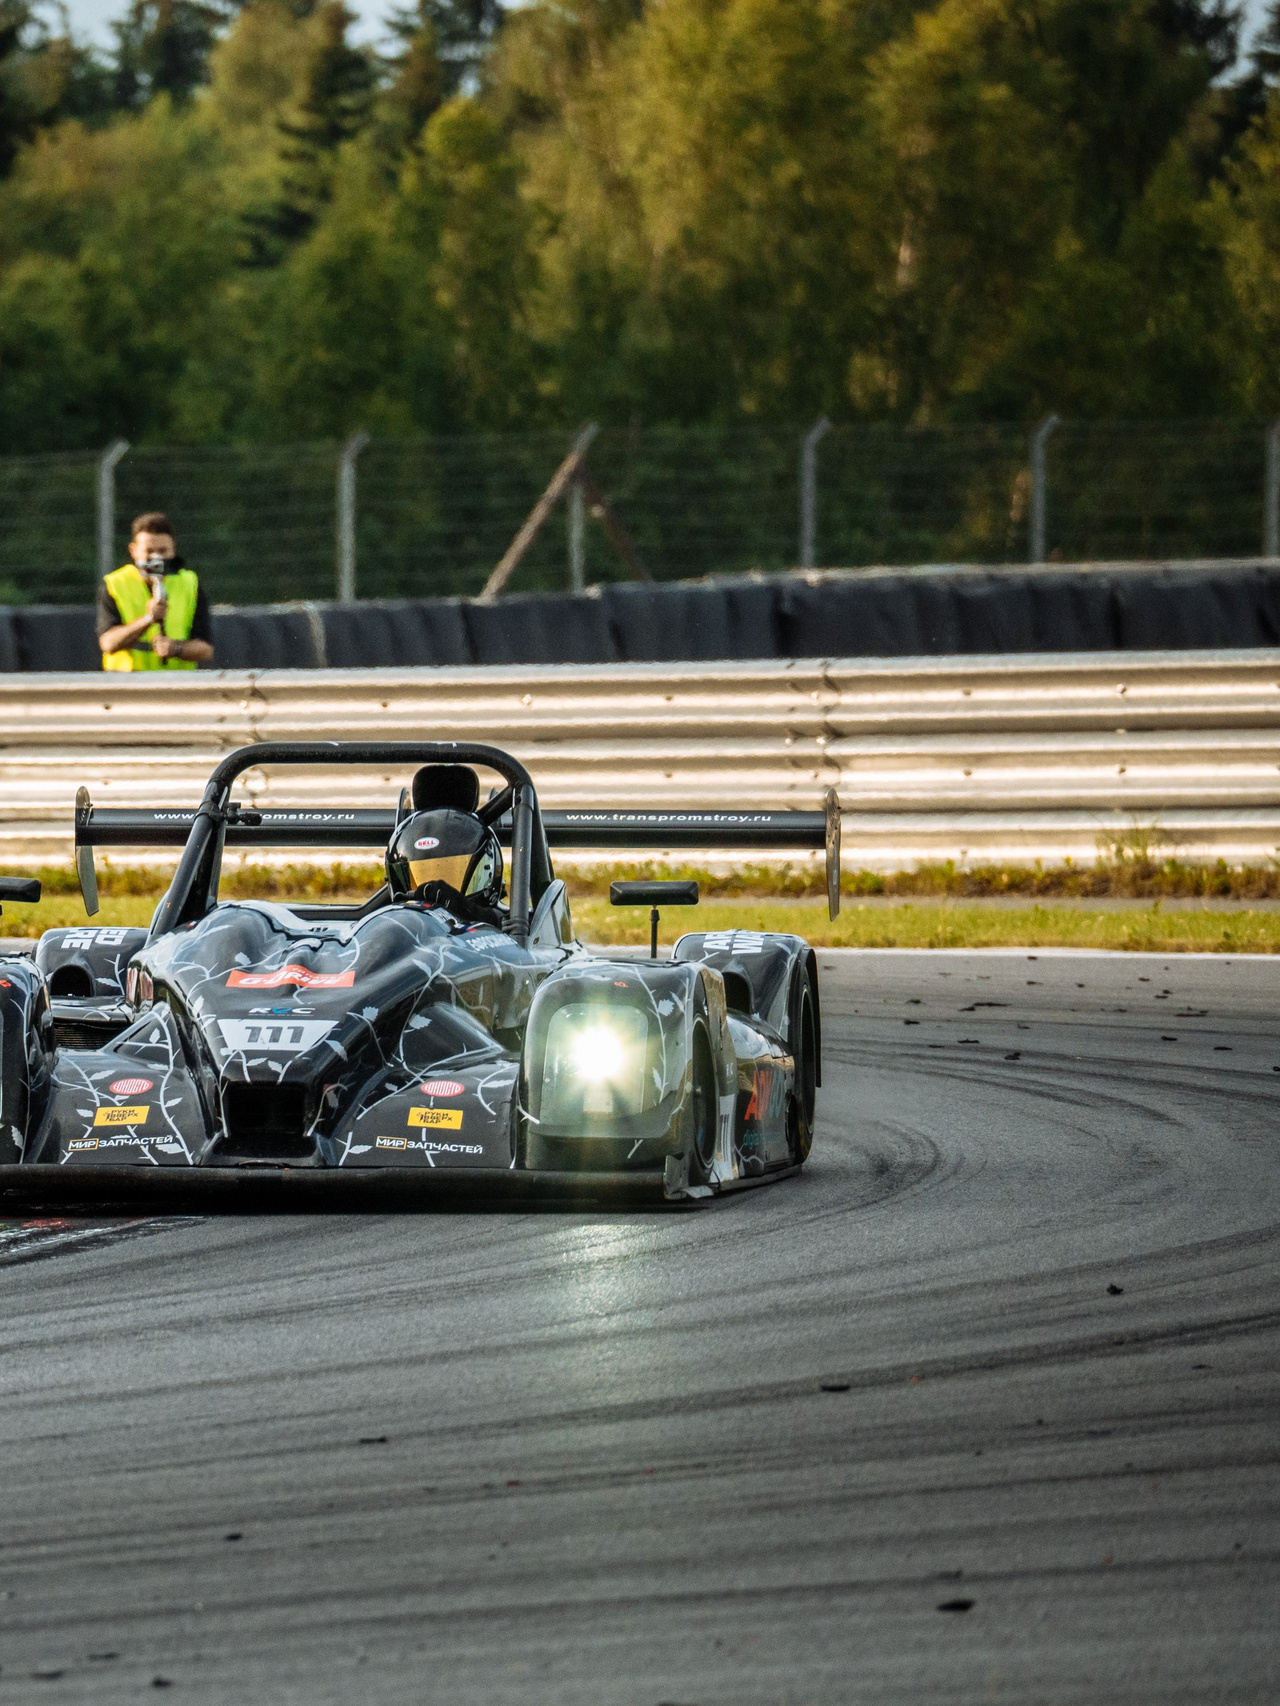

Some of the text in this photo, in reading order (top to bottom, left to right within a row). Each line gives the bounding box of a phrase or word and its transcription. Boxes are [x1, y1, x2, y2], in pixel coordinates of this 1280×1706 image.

[566, 813, 771, 823] www.transpromstroy.ru
[245, 1026, 305, 1043] 111
[113, 1079, 150, 1093] ЮНОСТЬ
[424, 1082, 461, 1095] ЮНОСТЬ
[69, 1135, 174, 1149] МИР ЗАПЧАСТЕЙ
[377, 1138, 483, 1154] МИР ЗАПЧАСТЕЙ
